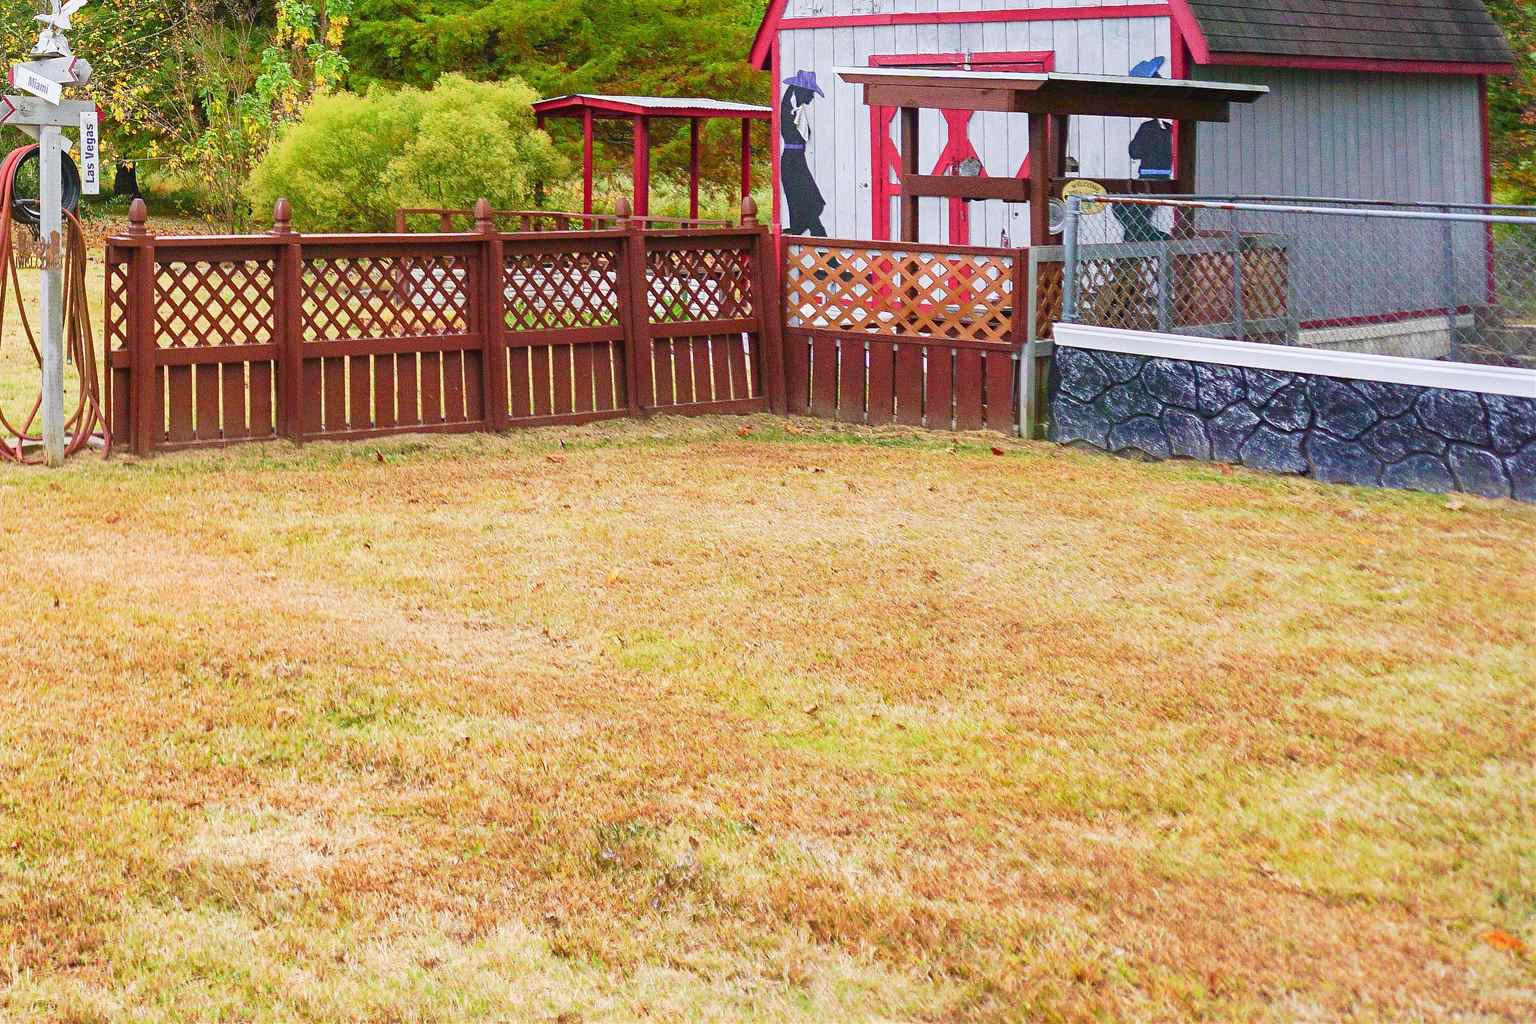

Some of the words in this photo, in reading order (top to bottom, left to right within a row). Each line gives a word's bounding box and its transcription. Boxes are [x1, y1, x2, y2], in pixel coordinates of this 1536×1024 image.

[27, 76, 49, 95] Miami
[85, 123, 96, 160] Vegas
[85, 163, 95, 184] Las
